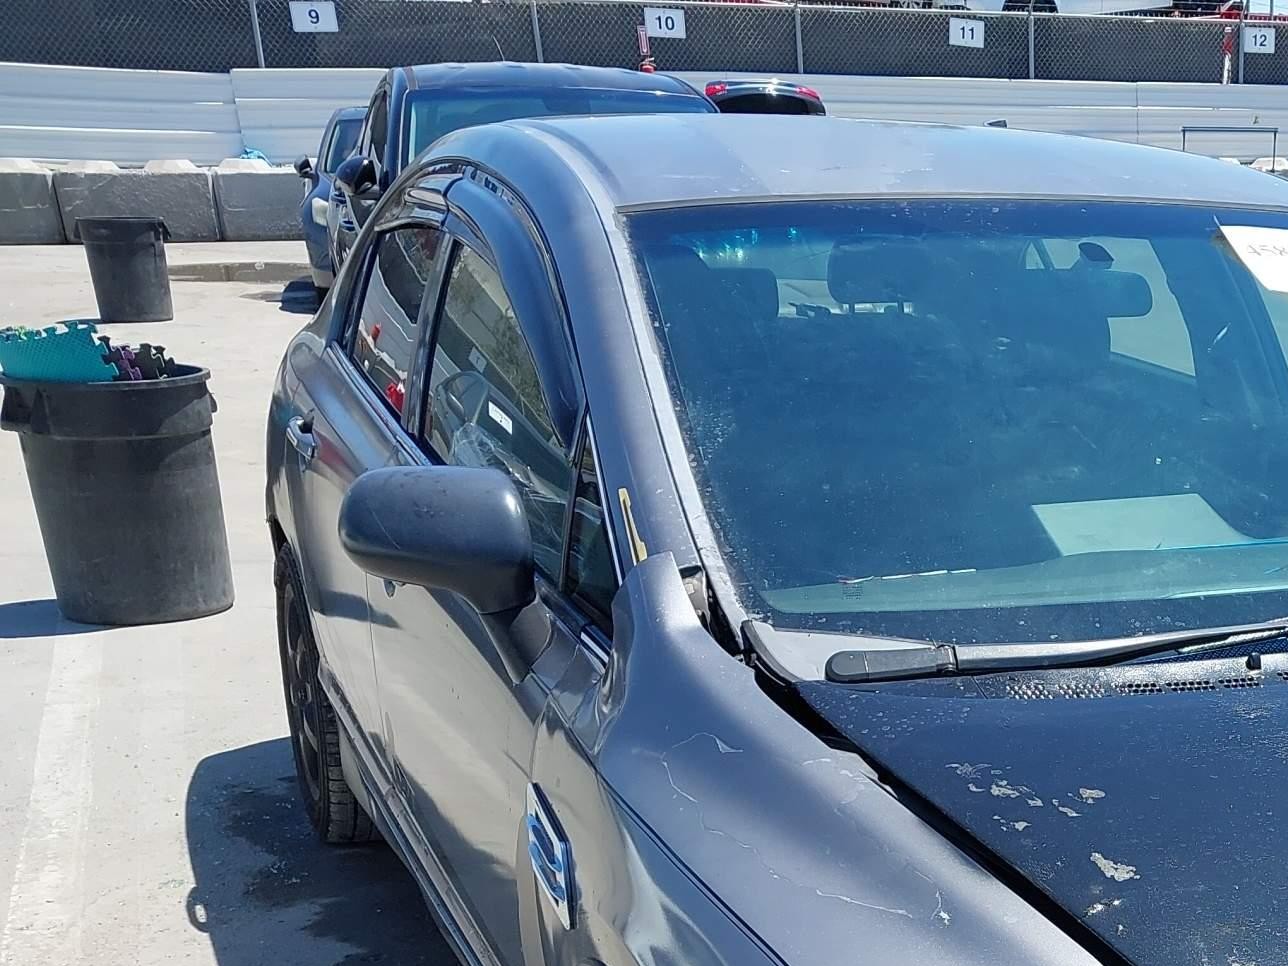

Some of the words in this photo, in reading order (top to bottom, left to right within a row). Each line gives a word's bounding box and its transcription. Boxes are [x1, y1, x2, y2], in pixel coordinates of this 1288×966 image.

[308, 9, 320, 24] 9
[655, 15, 675, 31] 10
[960, 26, 976, 40] 11
[1252, 34, 1267, 47] 12
